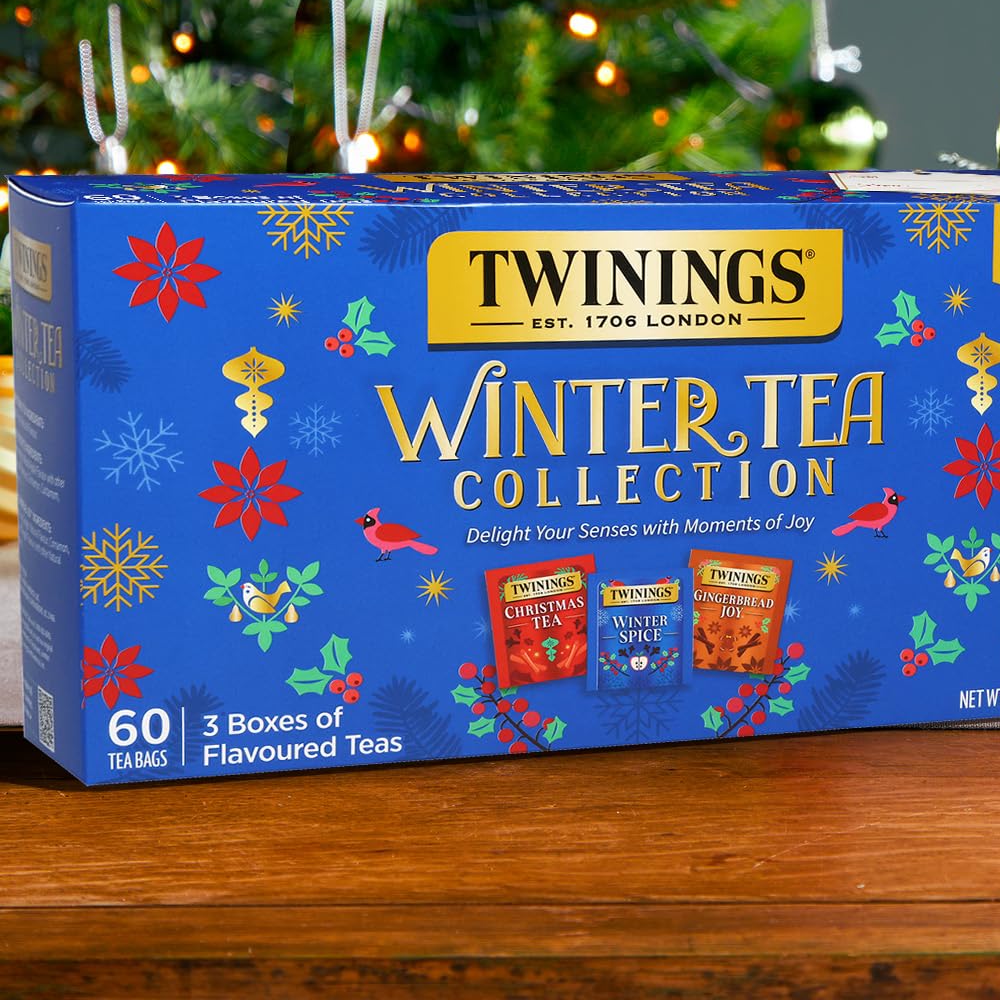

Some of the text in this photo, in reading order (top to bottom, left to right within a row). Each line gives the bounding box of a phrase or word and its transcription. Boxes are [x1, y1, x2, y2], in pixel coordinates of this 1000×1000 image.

[531, 313, 743, 329] EST. 1706 LONDON
[375, 359, 886, 463] WINTER TEA
[453, 457, 836, 510] COLLECTION
[466, 513, 816, 545] Delight Your Senses with Moments of Joy
[504, 596, 585, 619] CHRISTMAS
[694, 589, 774, 609] GINGERBREAD
[532, 613, 563, 630] TEA
[612, 615, 668, 629] WINTER
[619, 629, 662, 643] SPICE
[959, 689, 984, 709] NET
[108, 708, 170, 747] 60
[203, 706, 343, 737] 3 Boxes of
[108, 750, 168, 770] TEA BAGS
[203, 735, 403, 766] Flavoured Teas
